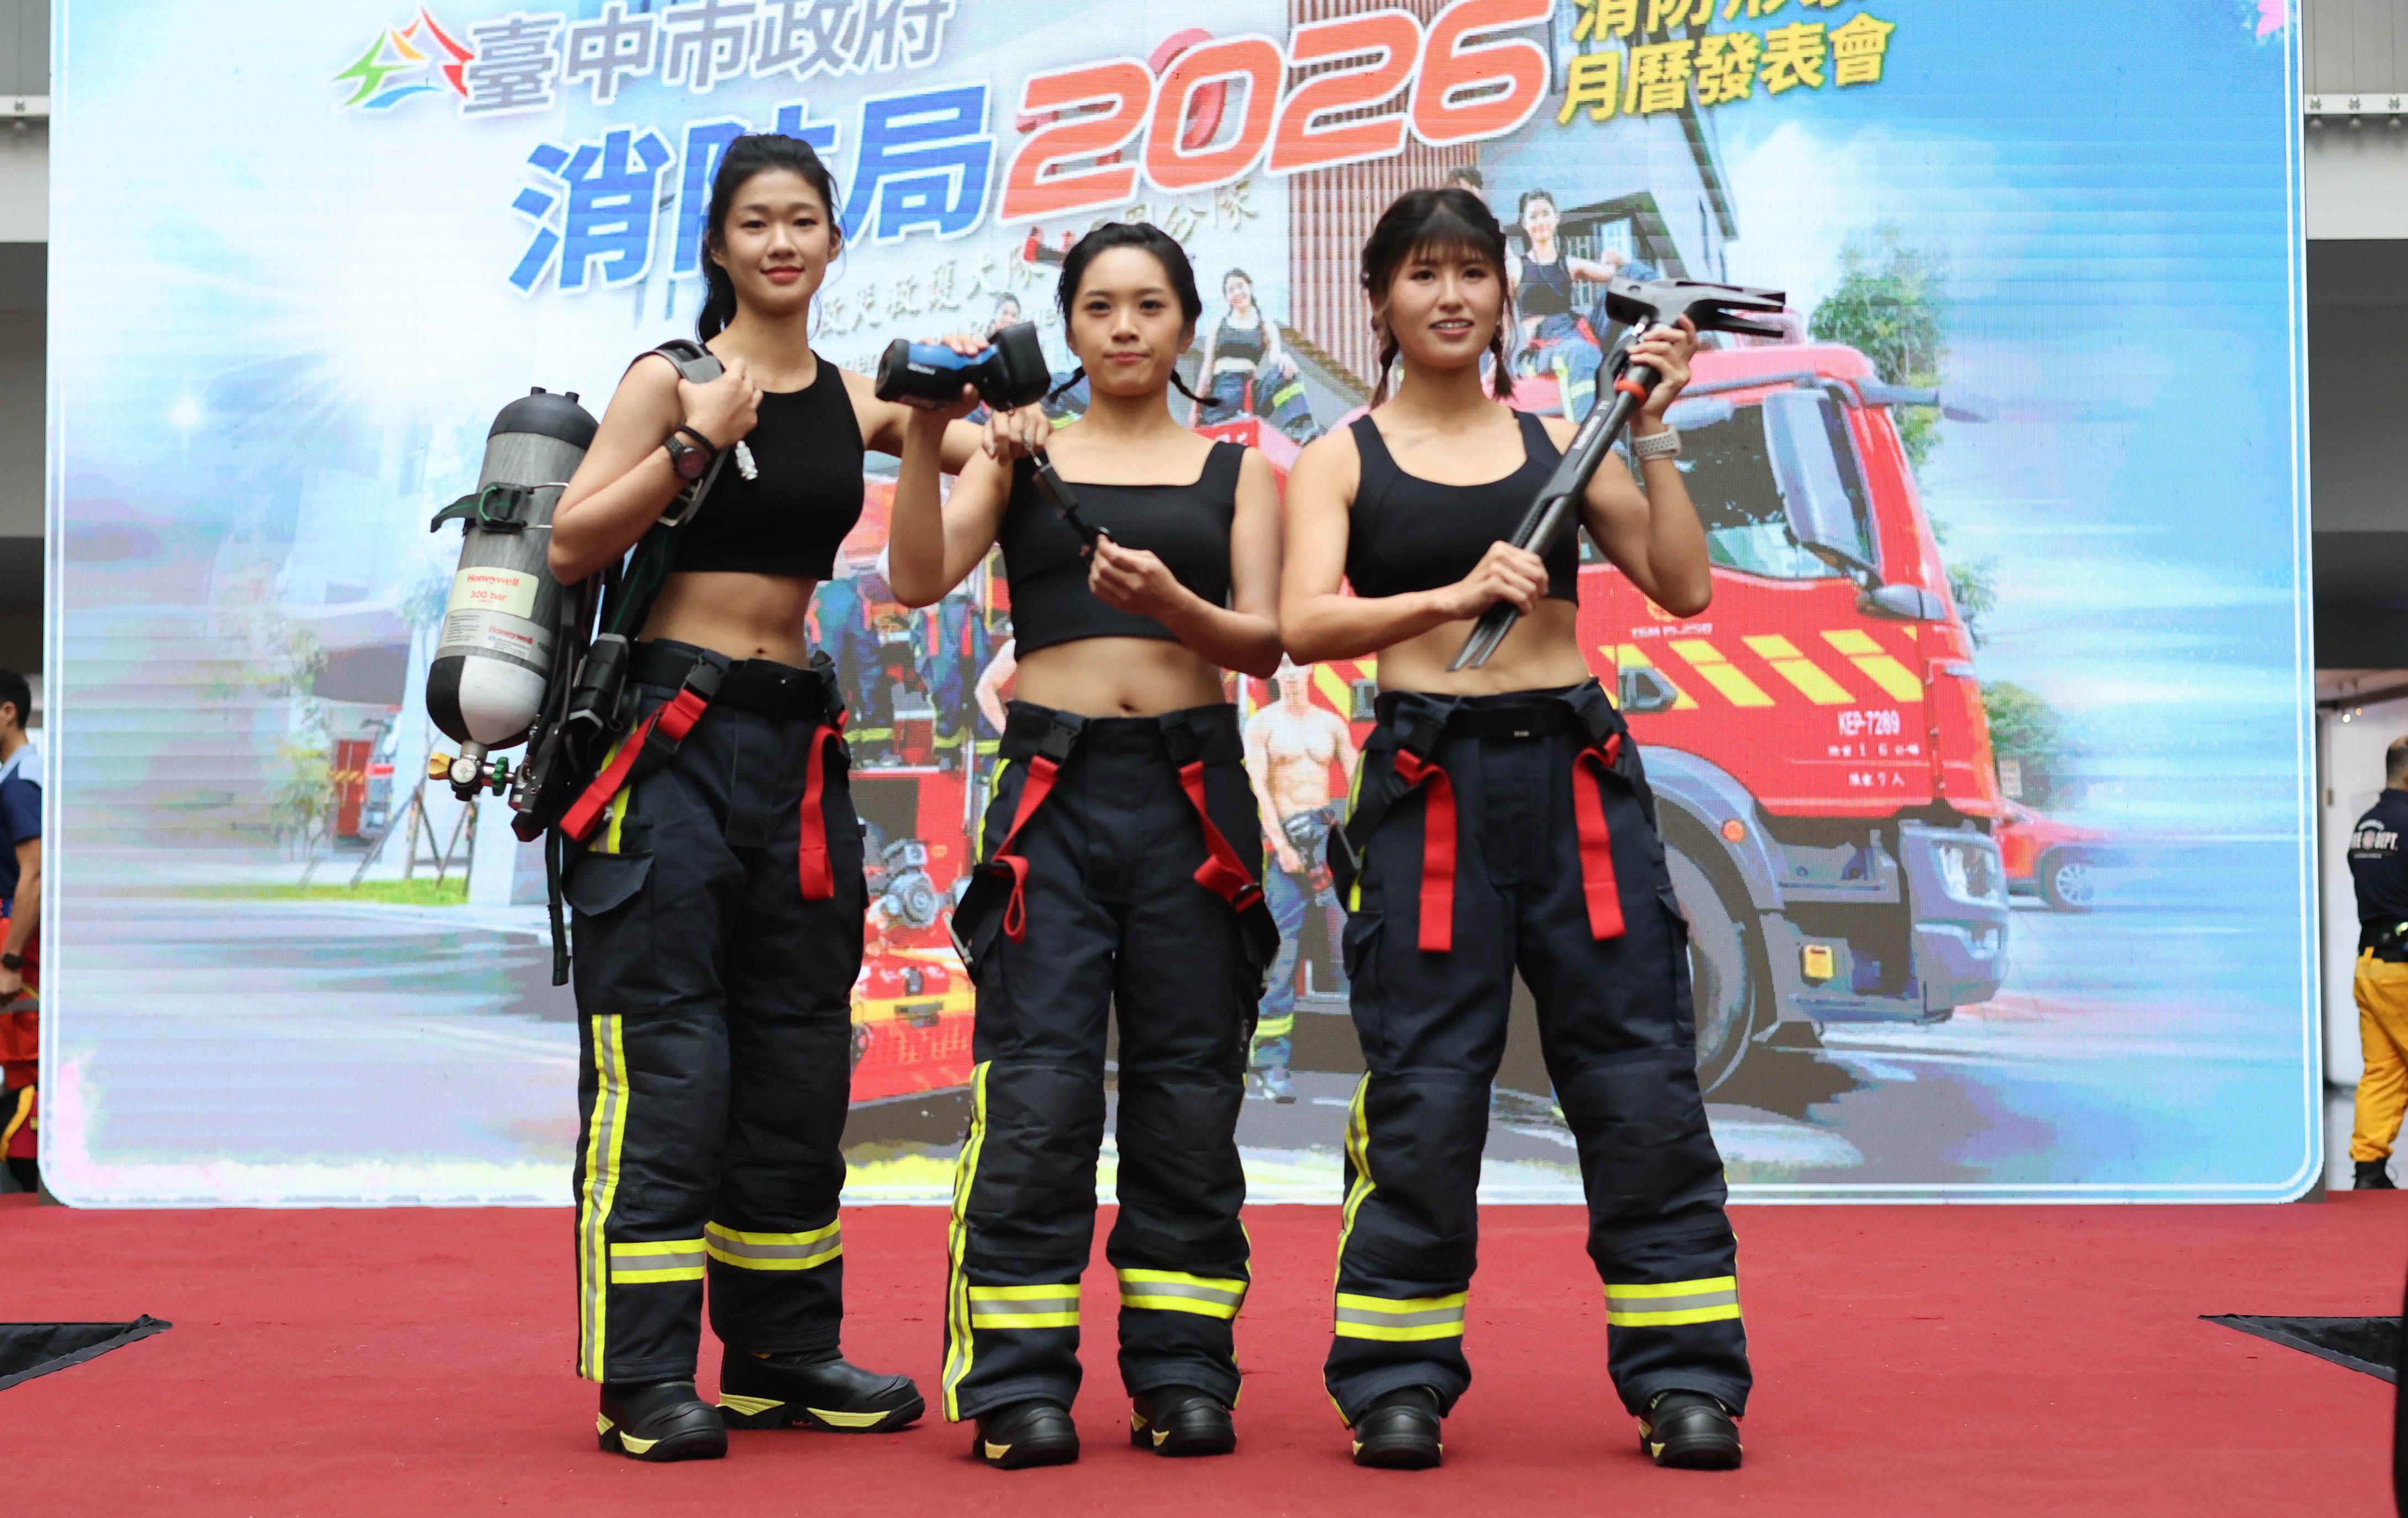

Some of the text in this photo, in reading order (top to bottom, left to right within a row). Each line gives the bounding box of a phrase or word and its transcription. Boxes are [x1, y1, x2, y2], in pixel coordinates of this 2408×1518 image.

[463, 0, 950, 113] 臺中市政府
[1557, 12, 1896, 125] 月曆發表會
[1001, 0, 1552, 220] 2026
[467, 574, 520, 587] Honeywell
[470, 590, 487, 599] 300
[490, 591, 507, 602] bar
[489, 625, 534, 645] Honeywell
